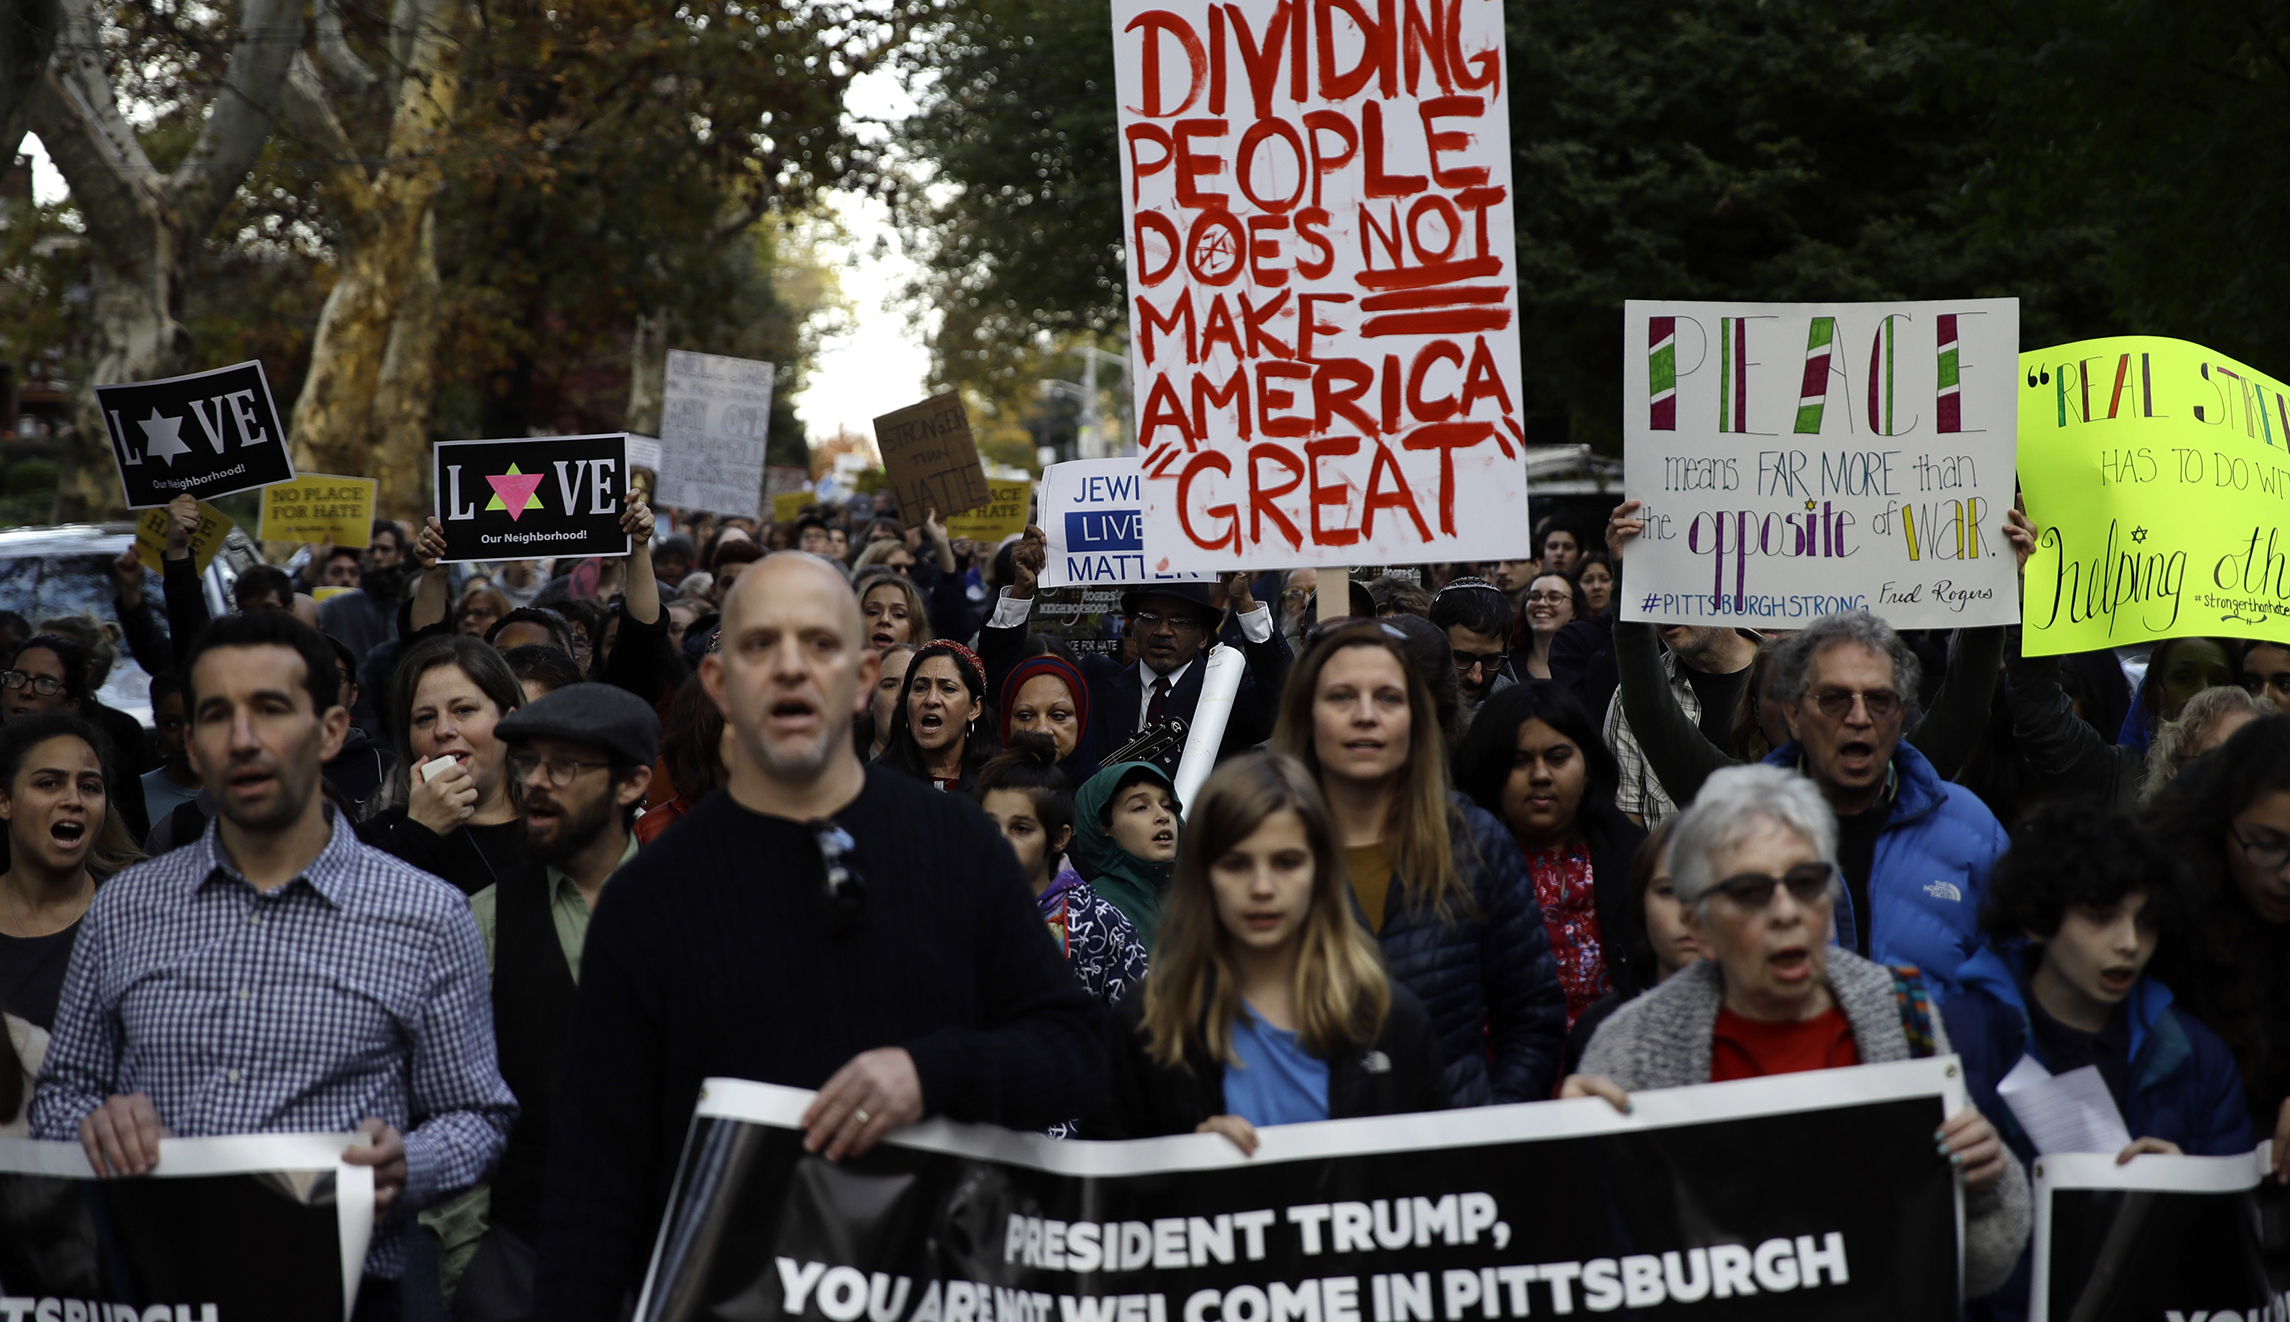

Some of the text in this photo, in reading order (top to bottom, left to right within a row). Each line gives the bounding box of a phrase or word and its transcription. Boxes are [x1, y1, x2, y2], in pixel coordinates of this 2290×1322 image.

[1124, 0, 1500, 119] DIVIDING
[1126, 96, 1491, 214] PEOPLE
[1134, 185, 1506, 287] DOES NOT
[1135, 285, 1355, 368] MAKE
[1139, 334, 1513, 452] AMERICA
[1648, 312, 1988, 437] PEACE
[109, 388, 268, 466] LVE
[882, 405, 968, 452] STRONGER
[152, 463, 246, 490] Our Neighborhood!
[910, 445, 949, 465] THAN
[1665, 449, 1977, 498] means FAR MORE than
[2101, 447, 2157, 486] HAS
[2172, 448, 2204, 484] TO
[2214, 452, 2249, 490] DO
[272, 487, 364, 502] NO PLACE
[272, 504, 363, 521] FOR HATE
[447, 458, 616, 521] LVE
[896, 462, 989, 525] HATE
[976, 504, 1020, 518] HATE
[481, 530, 588, 545] Our Neighborhood!
[1636, 506, 1677, 540] the
[1688, 498, 1861, 611] opposite
[1872, 499, 1898, 536] of
[1067, 555, 1199, 581] MATT
[2032, 518, 2290, 639] helping oth
[1040, 603, 1108, 614] NEIGHBORHOOD
[1640, 592, 1870, 617] #PITTSBURGHSTRONG
[1879, 579, 1994, 612] Fred Rogers
[1082, 640, 1095, 650] FOR
[1097, 640, 1117, 650] HATE
[1005, 1191, 1511, 1273] PRESIDENT TRUMP,
[775, 1256, 911, 1322] YOU
[909, 1279, 994, 1322] ARE
[995, 1286, 1052, 1322] NOT
[1372, 1271, 1433, 1322] IN
[1442, 1231, 1850, 1321] PITTSBURGH
